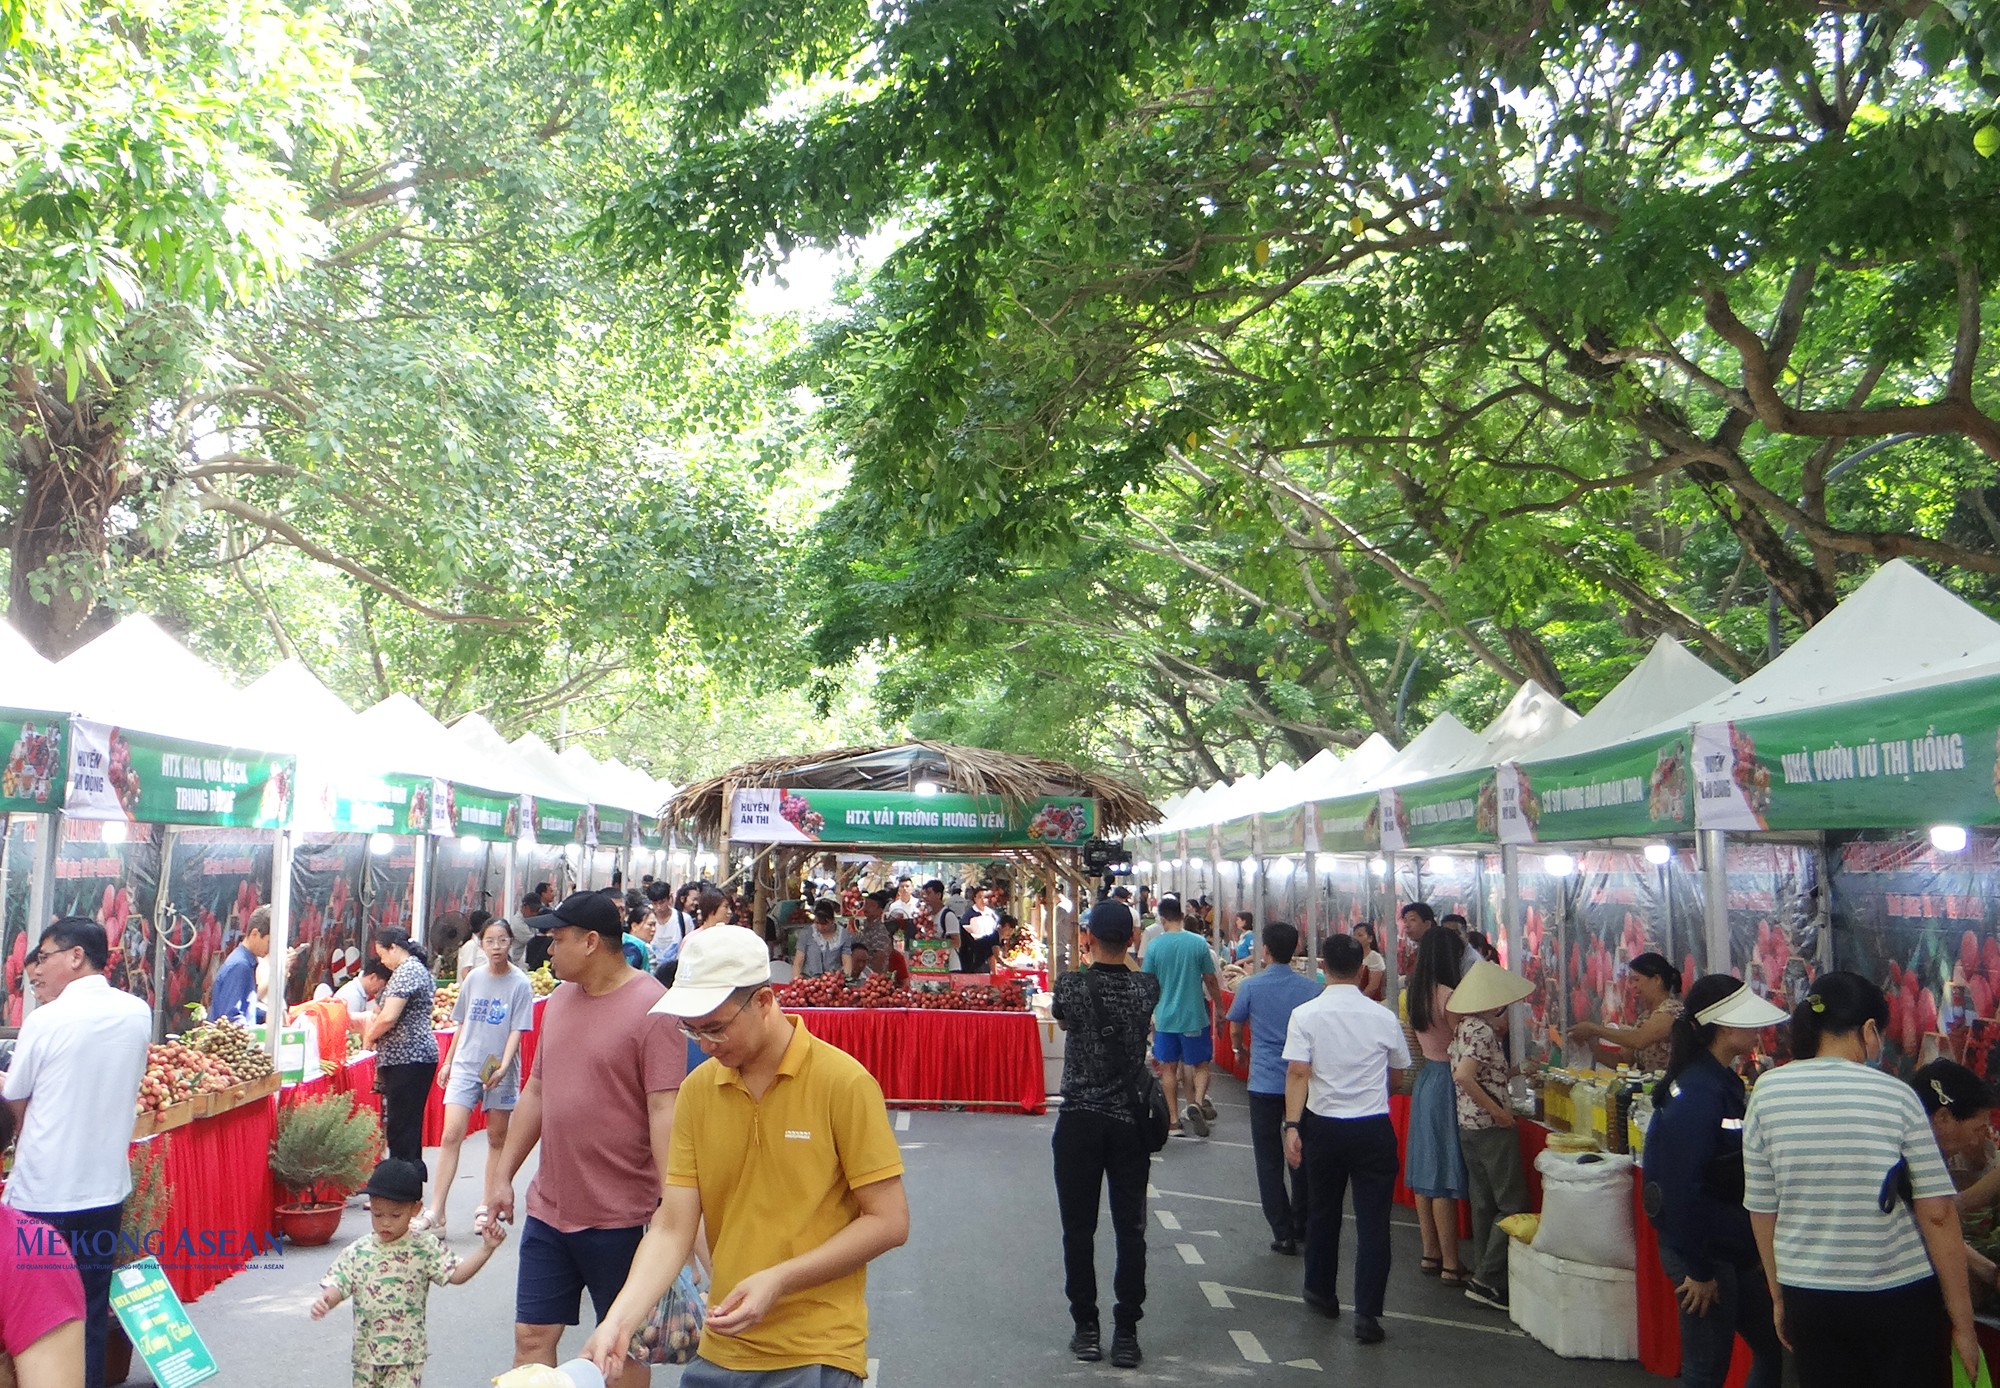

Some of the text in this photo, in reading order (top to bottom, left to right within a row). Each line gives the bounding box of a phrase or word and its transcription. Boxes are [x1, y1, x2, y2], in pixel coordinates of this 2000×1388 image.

[1881, 740, 1910, 782] THỊ
[755, 815, 769, 825] THI
[846, 810, 870, 825] HTX
[873, 806, 894, 826] VẢI
[897, 808, 939, 826] TRỨNG
[942, 810, 977, 828] HƯNG
